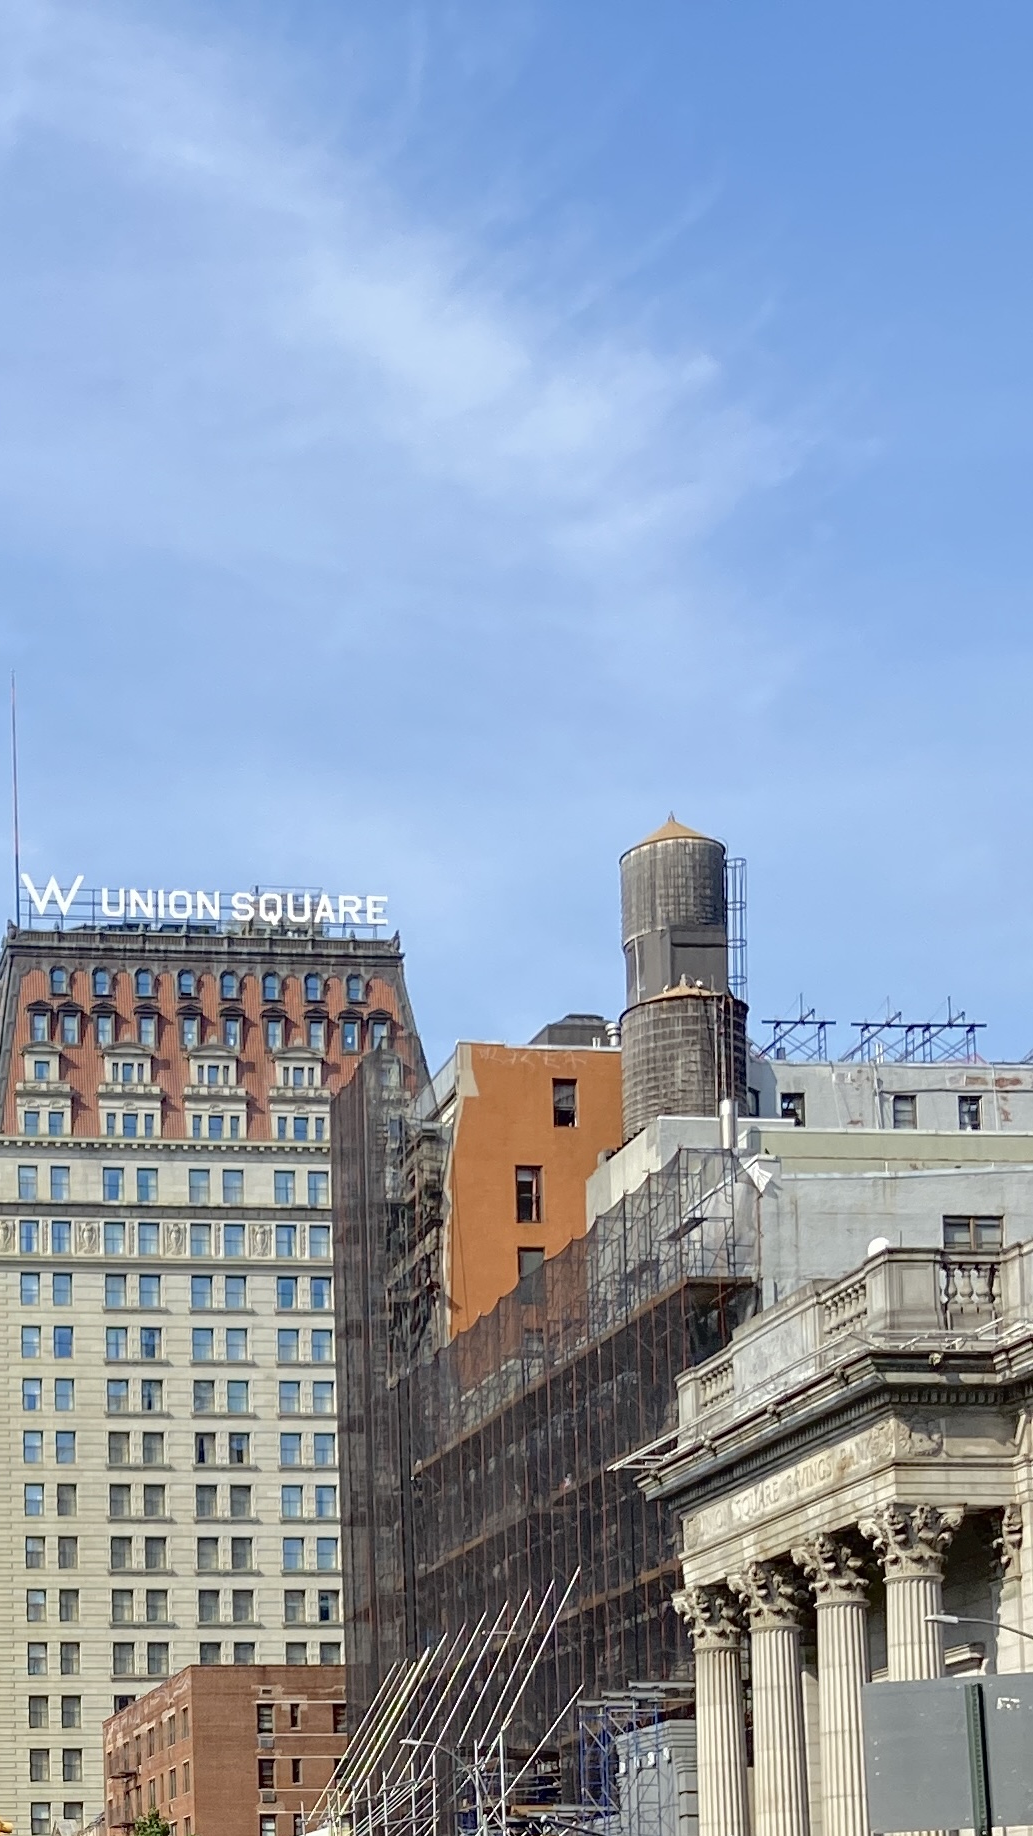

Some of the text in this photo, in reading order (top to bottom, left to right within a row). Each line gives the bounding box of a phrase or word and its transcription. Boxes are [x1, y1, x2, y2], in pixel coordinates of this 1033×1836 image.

[20, 873, 389, 926] W UNION SQUARE
[785, 1456, 832, 1495] SAVINGS
